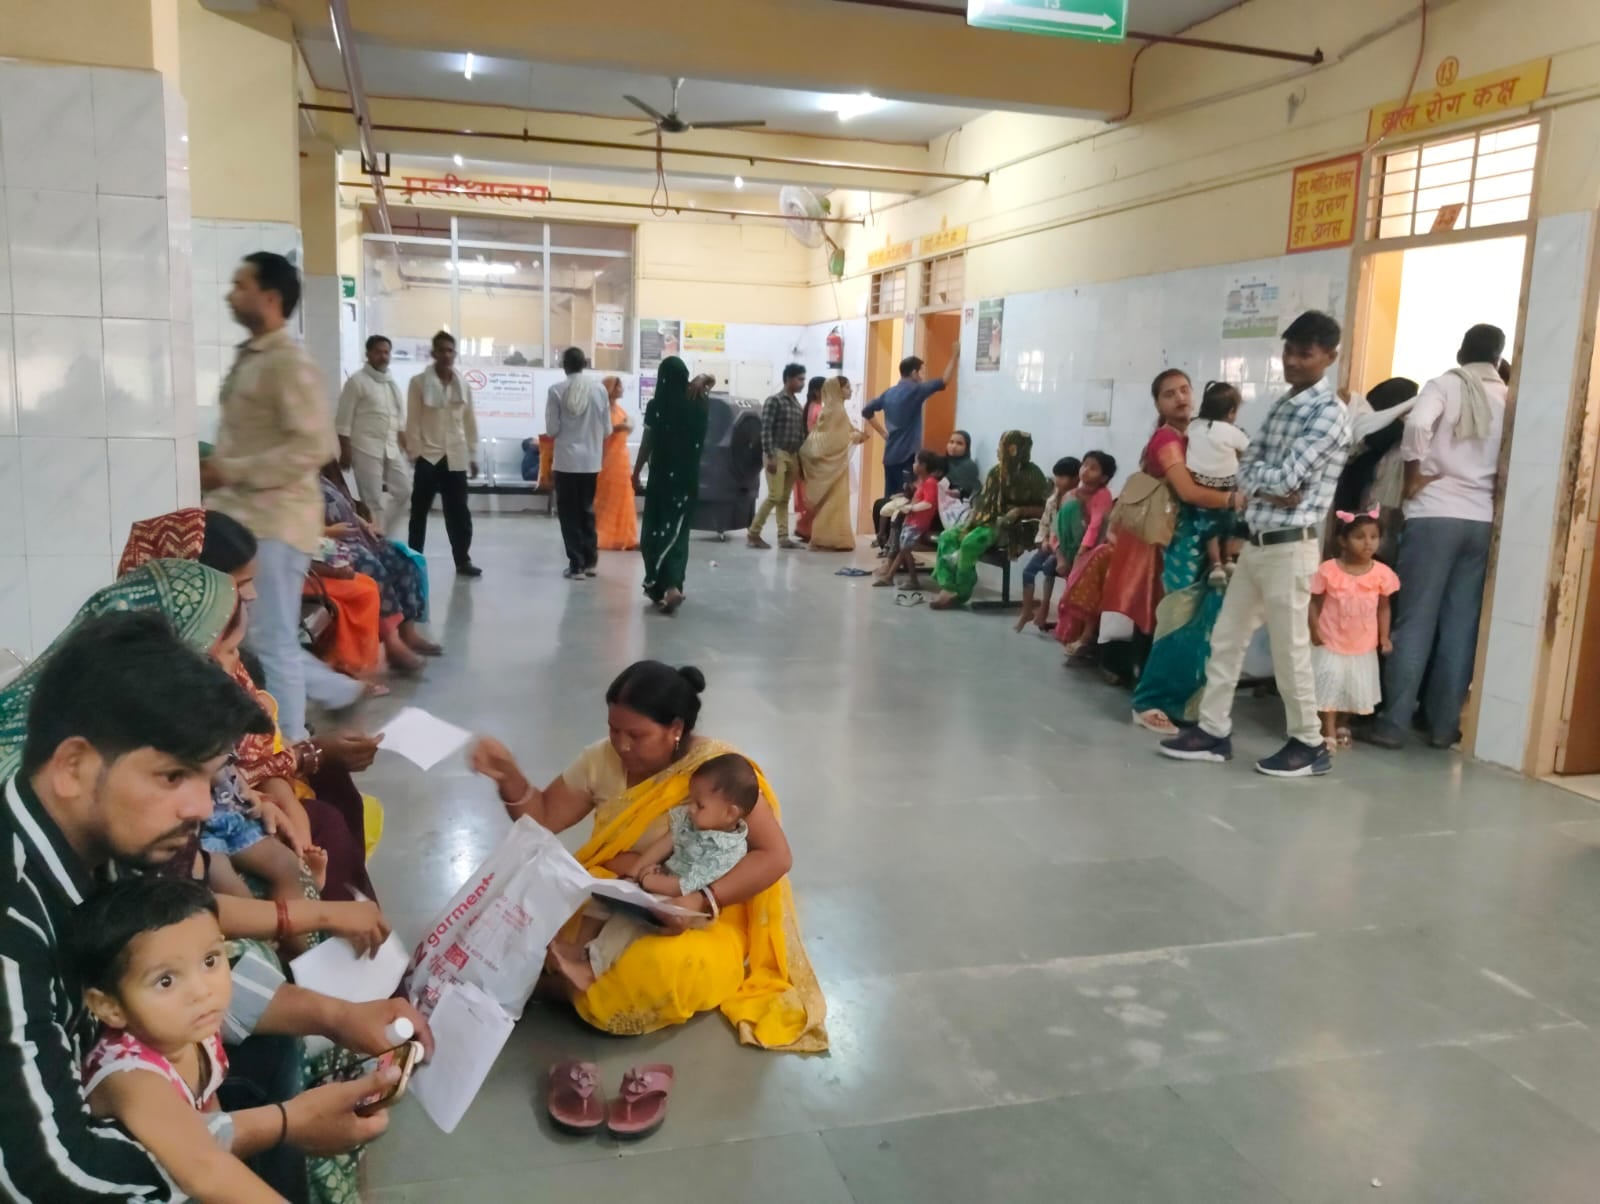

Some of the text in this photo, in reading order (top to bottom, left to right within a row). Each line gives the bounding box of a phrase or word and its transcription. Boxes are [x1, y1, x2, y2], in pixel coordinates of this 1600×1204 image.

[1426, 91, 1466, 122] रोग
[1473, 76, 1520, 108] कक्ष
[400, 173, 549, 205] प्रतीक्षालय
